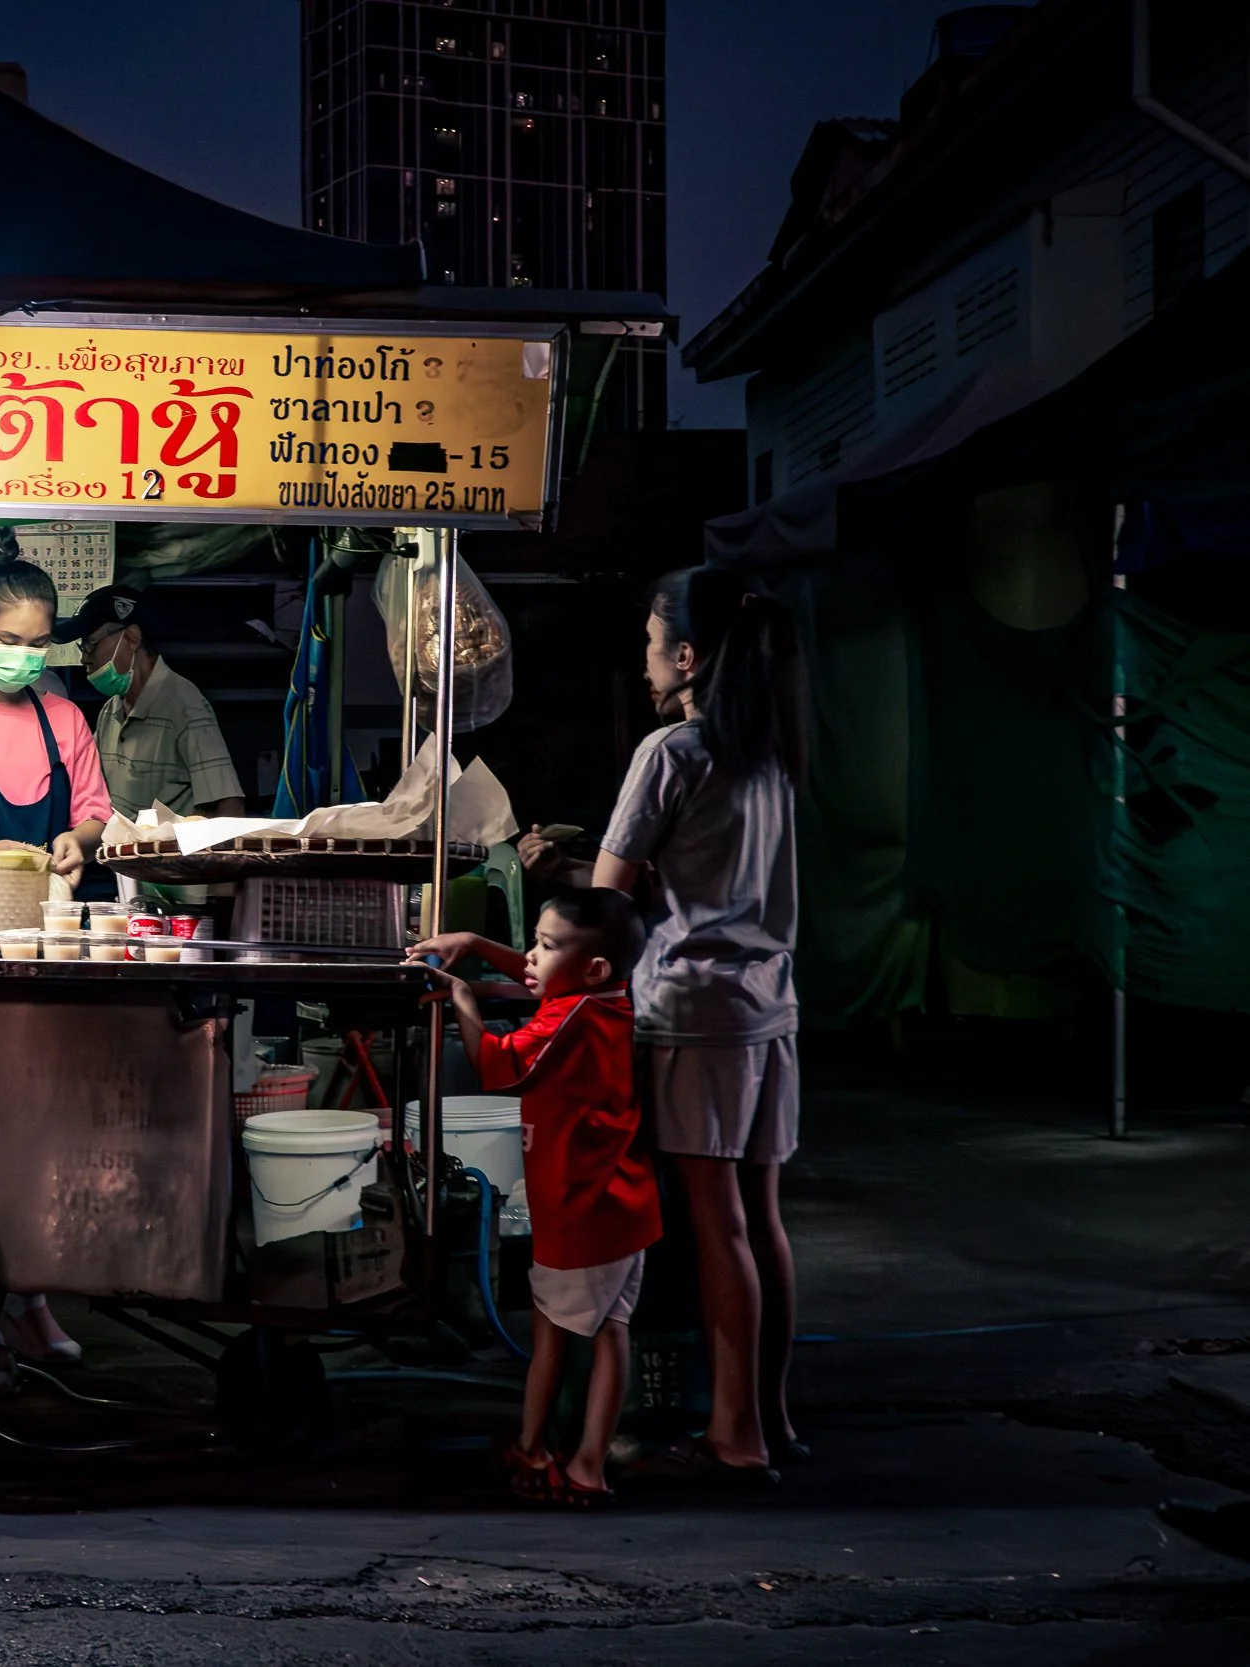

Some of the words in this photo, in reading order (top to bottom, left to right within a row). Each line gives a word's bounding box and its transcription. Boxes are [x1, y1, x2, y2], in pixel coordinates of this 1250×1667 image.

[270, 391, 402, 424] ซาลาเปา
[270, 431, 379, 466] ฟักทอง
[121, 469, 165, 500] 12
[278, 471, 416, 509] ขนมปังสังขยา
[424, 481, 455, 510] 25
[463, 486, 505, 511] บาท
